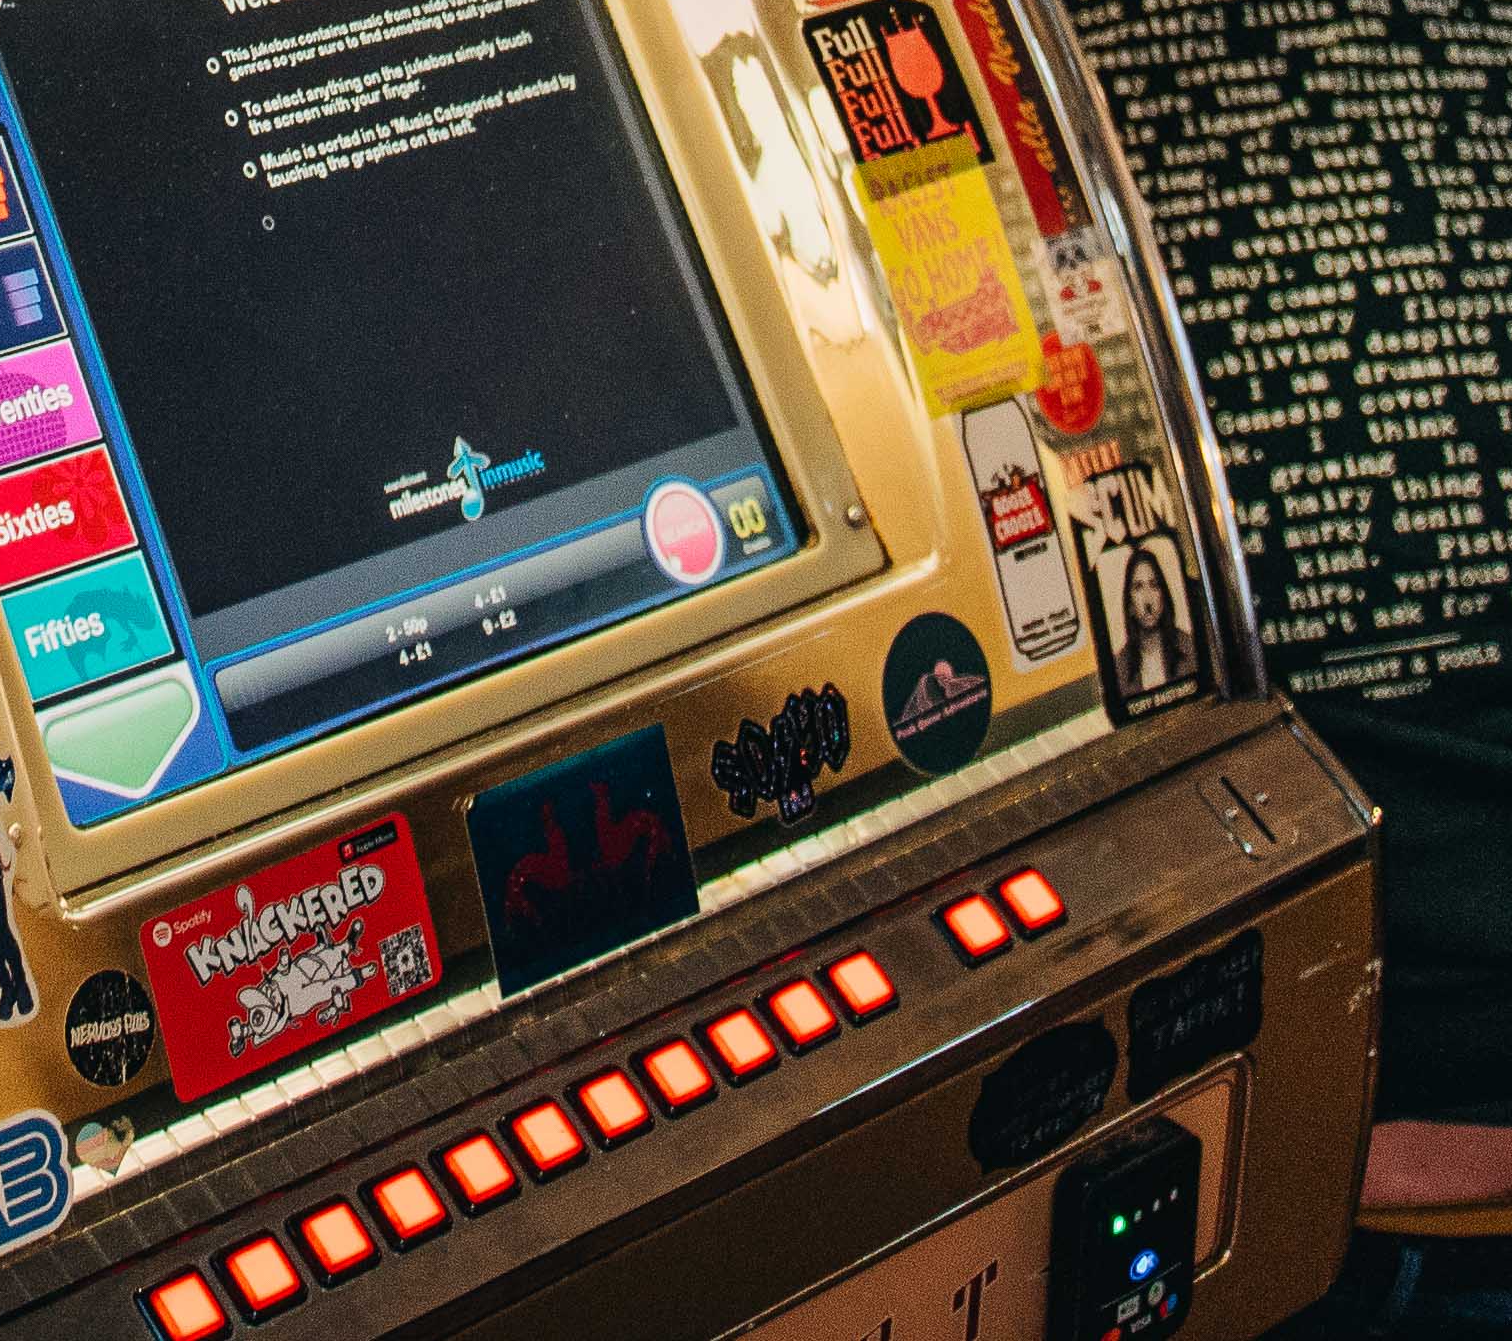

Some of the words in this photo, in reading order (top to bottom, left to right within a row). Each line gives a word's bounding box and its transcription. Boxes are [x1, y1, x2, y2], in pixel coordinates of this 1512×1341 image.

[222, 48, 249, 65] This
[250, 35, 297, 60] jukebox
[298, 22, 348, 46] contains
[349, 14, 384, 33] music
[384, 7, 412, 25] from
[228, 60, 272, 82] genres
[288, 47, 316, 67] your
[383, 15, 443, 40] something
[476, 0, 504, 19] your
[812, 16, 876, 63] Full
[242, 100, 262, 117] To
[263, 88, 305, 113] select
[306, 76, 364, 102] anything
[363, 70, 382, 88] on
[381, 65, 404, 82] the
[403, 53, 455, 80] jukebox
[455, 39, 496, 63] simply
[496, 30, 534, 52] touch
[827, 47, 888, 92] Full
[248, 119, 272, 136] the
[273, 105, 321, 129] screen
[321, 96, 351, 117] with
[350, 90, 381, 112] your
[260, 147, 302, 171] Music
[318, 128, 361, 155] sorted
[361, 127, 376, 144] in
[376, 123, 391, 139] to
[506, 76, 560, 104] selected
[558, 73, 577, 91] by
[839, 78, 901, 125] Full
[267, 160, 328, 189] touching
[327, 153, 350, 172] the
[351, 138, 409, 170] graphics
[409, 133, 428, 149] on
[427, 126, 450, 143] the
[852, 109, 914, 161] Full
[1371, 268, 1446, 297] with
[1460, 265, 1512, 288] our
[1207, 338, 1350, 378] oblivion
[1366, 322, 1491, 354] despite
[1231, 308, 1355, 346] Fosbury
[1359, 384, 1448, 415] cover
[388, 477, 466, 519] milestones
[479, 448, 545, 487] inmusic
[1282, 486, 1373, 518] hairy
[1392, 471, 1483, 503] thing
[23, 612, 104, 659] Fifties
[173, 908, 212, 935] Spotify
[185, 864, 384, 987] KNACKERED
[71, 1018, 122, 1048] NERVOUS
